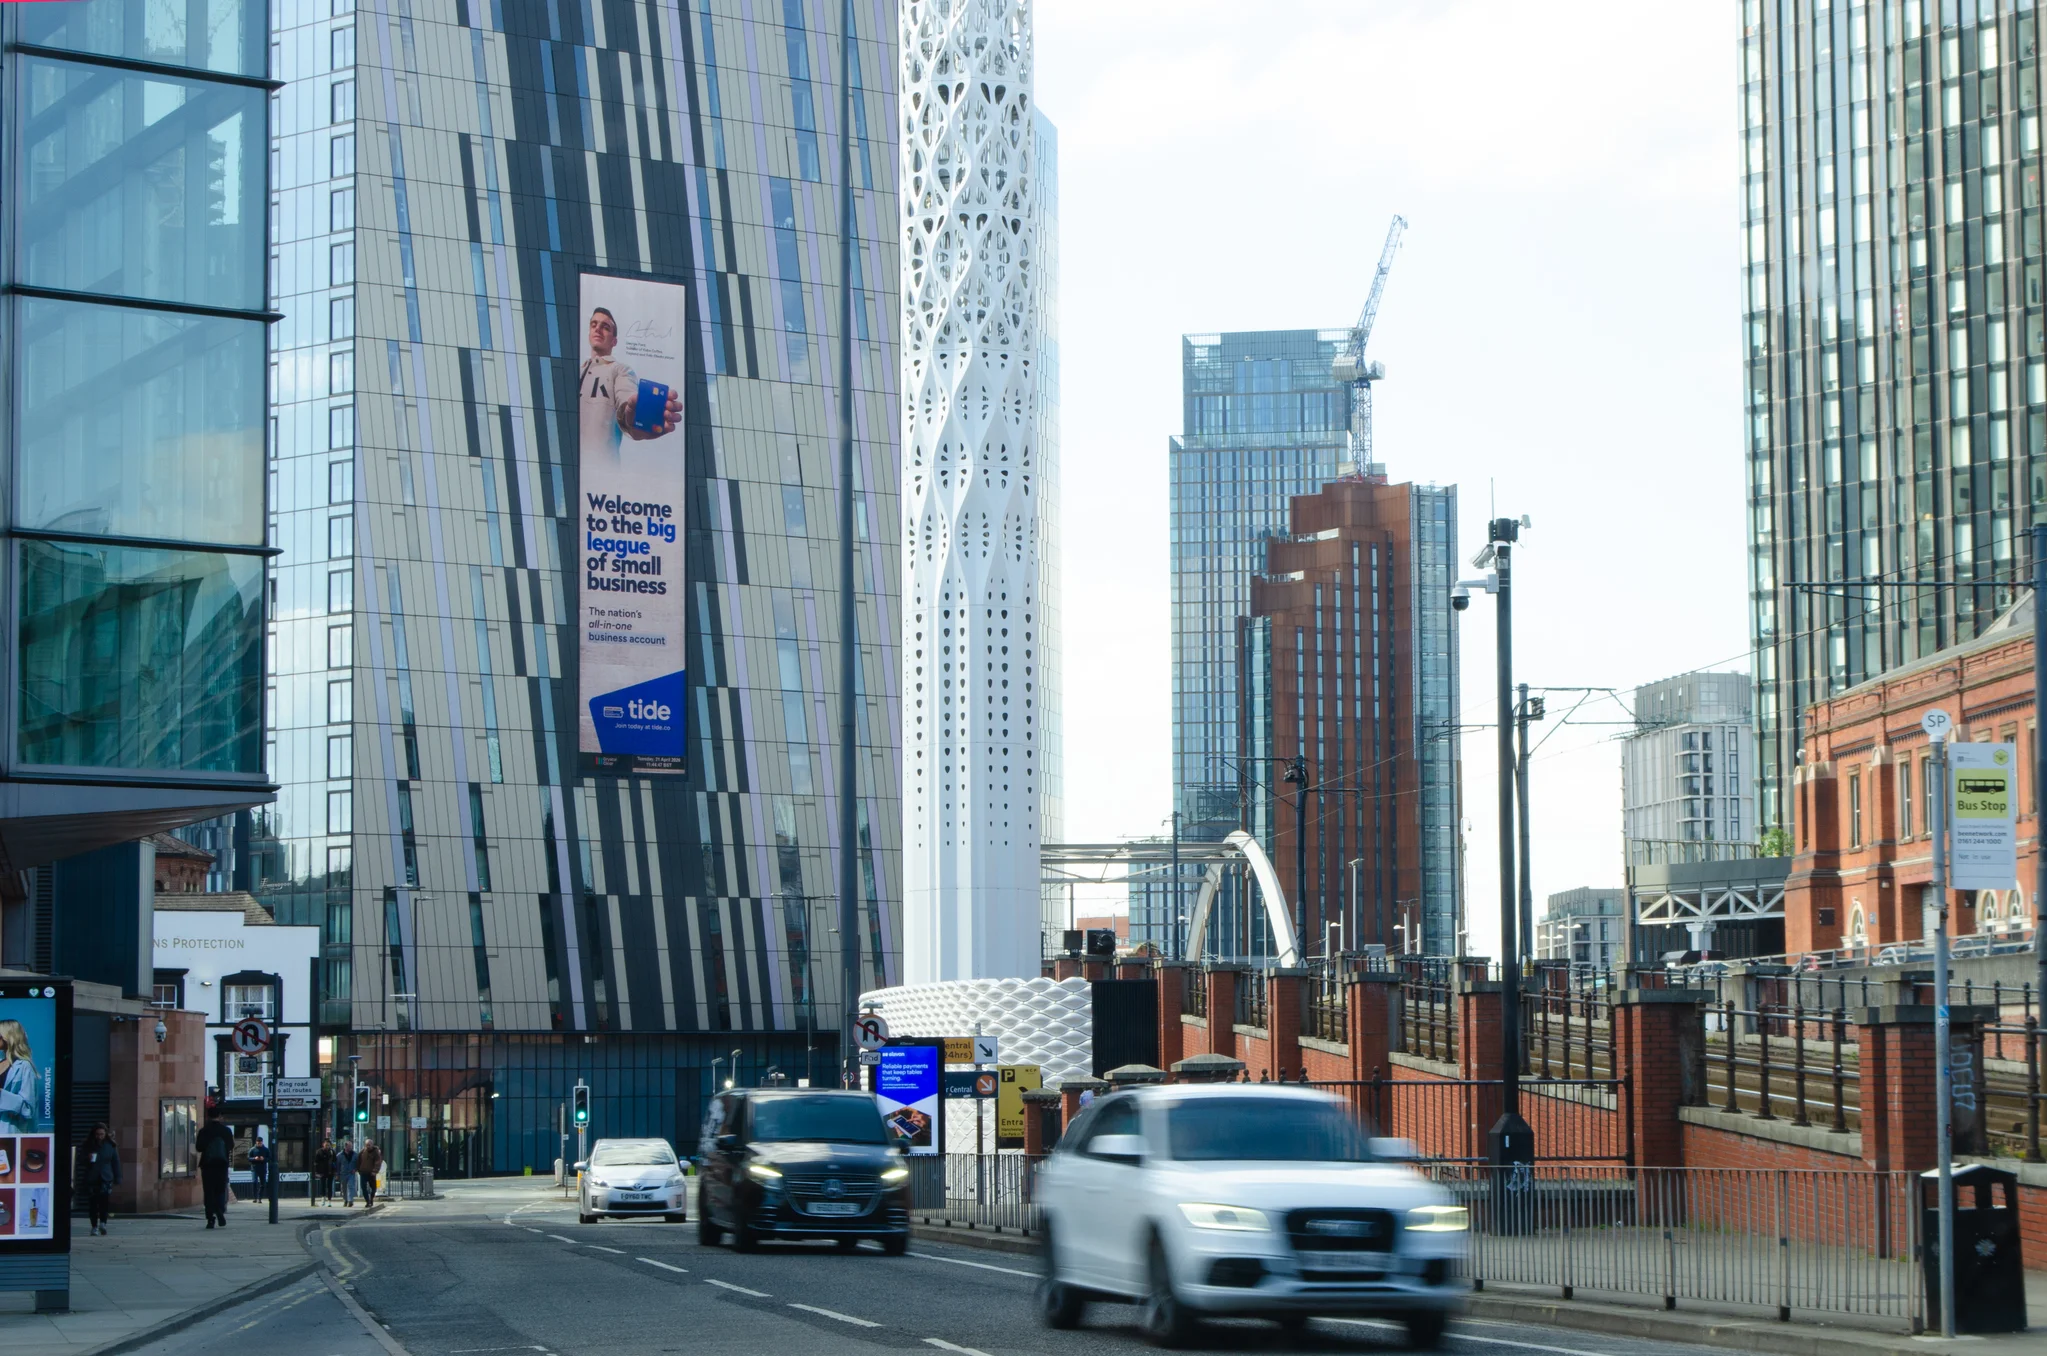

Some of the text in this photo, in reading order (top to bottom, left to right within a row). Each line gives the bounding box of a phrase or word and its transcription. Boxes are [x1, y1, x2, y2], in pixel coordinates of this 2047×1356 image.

[586, 493, 672, 518] Welcome
[586, 514, 676, 543] to the big
[587, 531, 650, 558] league
[587, 552, 661, 575] of small
[587, 571, 666, 595] business
[589, 607, 642, 618] The nation's
[589, 620, 632, 630] all-in-one
[588, 632, 665, 645] business account
[628, 699, 671, 720] tide
[1928, 714, 1946, 727] SP
[1957, 800, 2006, 813] Bus Stop
[173, 938, 245, 949] PROTECTION
[1004, 1070, 1014, 1081] P
